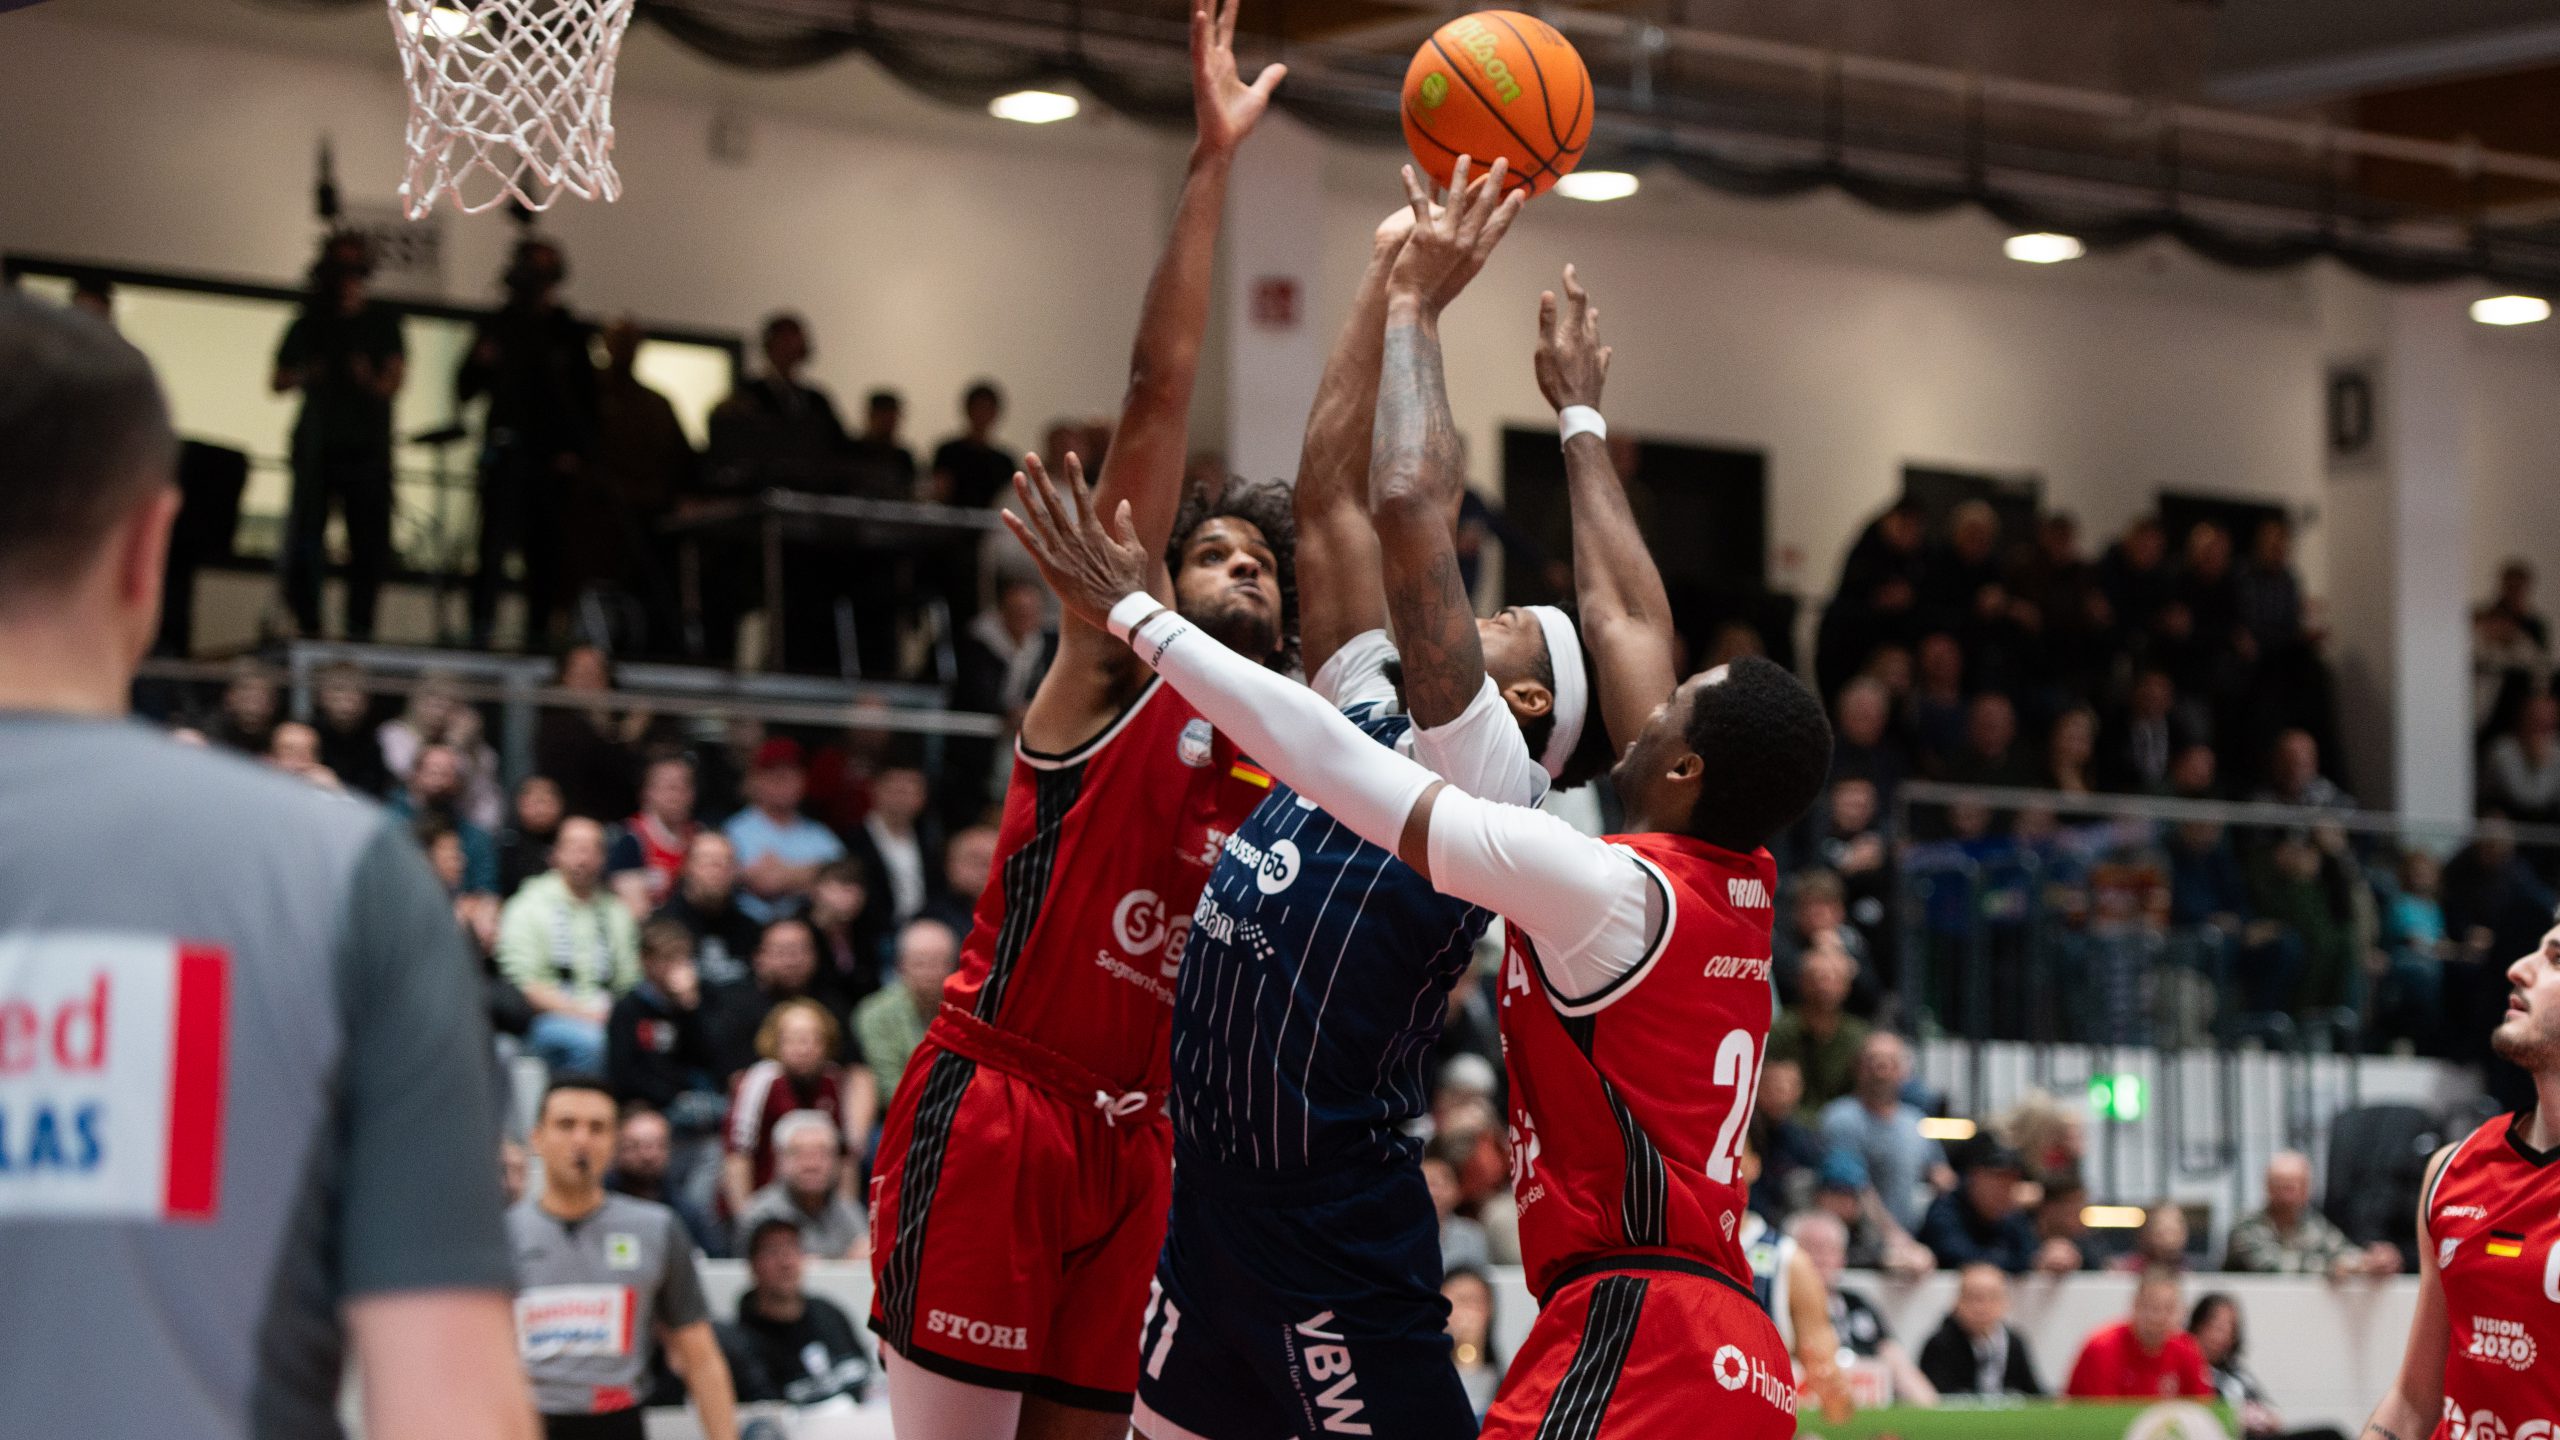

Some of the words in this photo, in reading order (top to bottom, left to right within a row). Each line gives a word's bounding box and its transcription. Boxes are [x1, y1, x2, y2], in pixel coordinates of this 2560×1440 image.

[1727, 877, 1771, 909] PRUI
[2472, 1315, 2525, 1338] VISION
[2468, 1332, 2530, 1362] 2030
[1295, 1310, 1373, 1436] VBW
